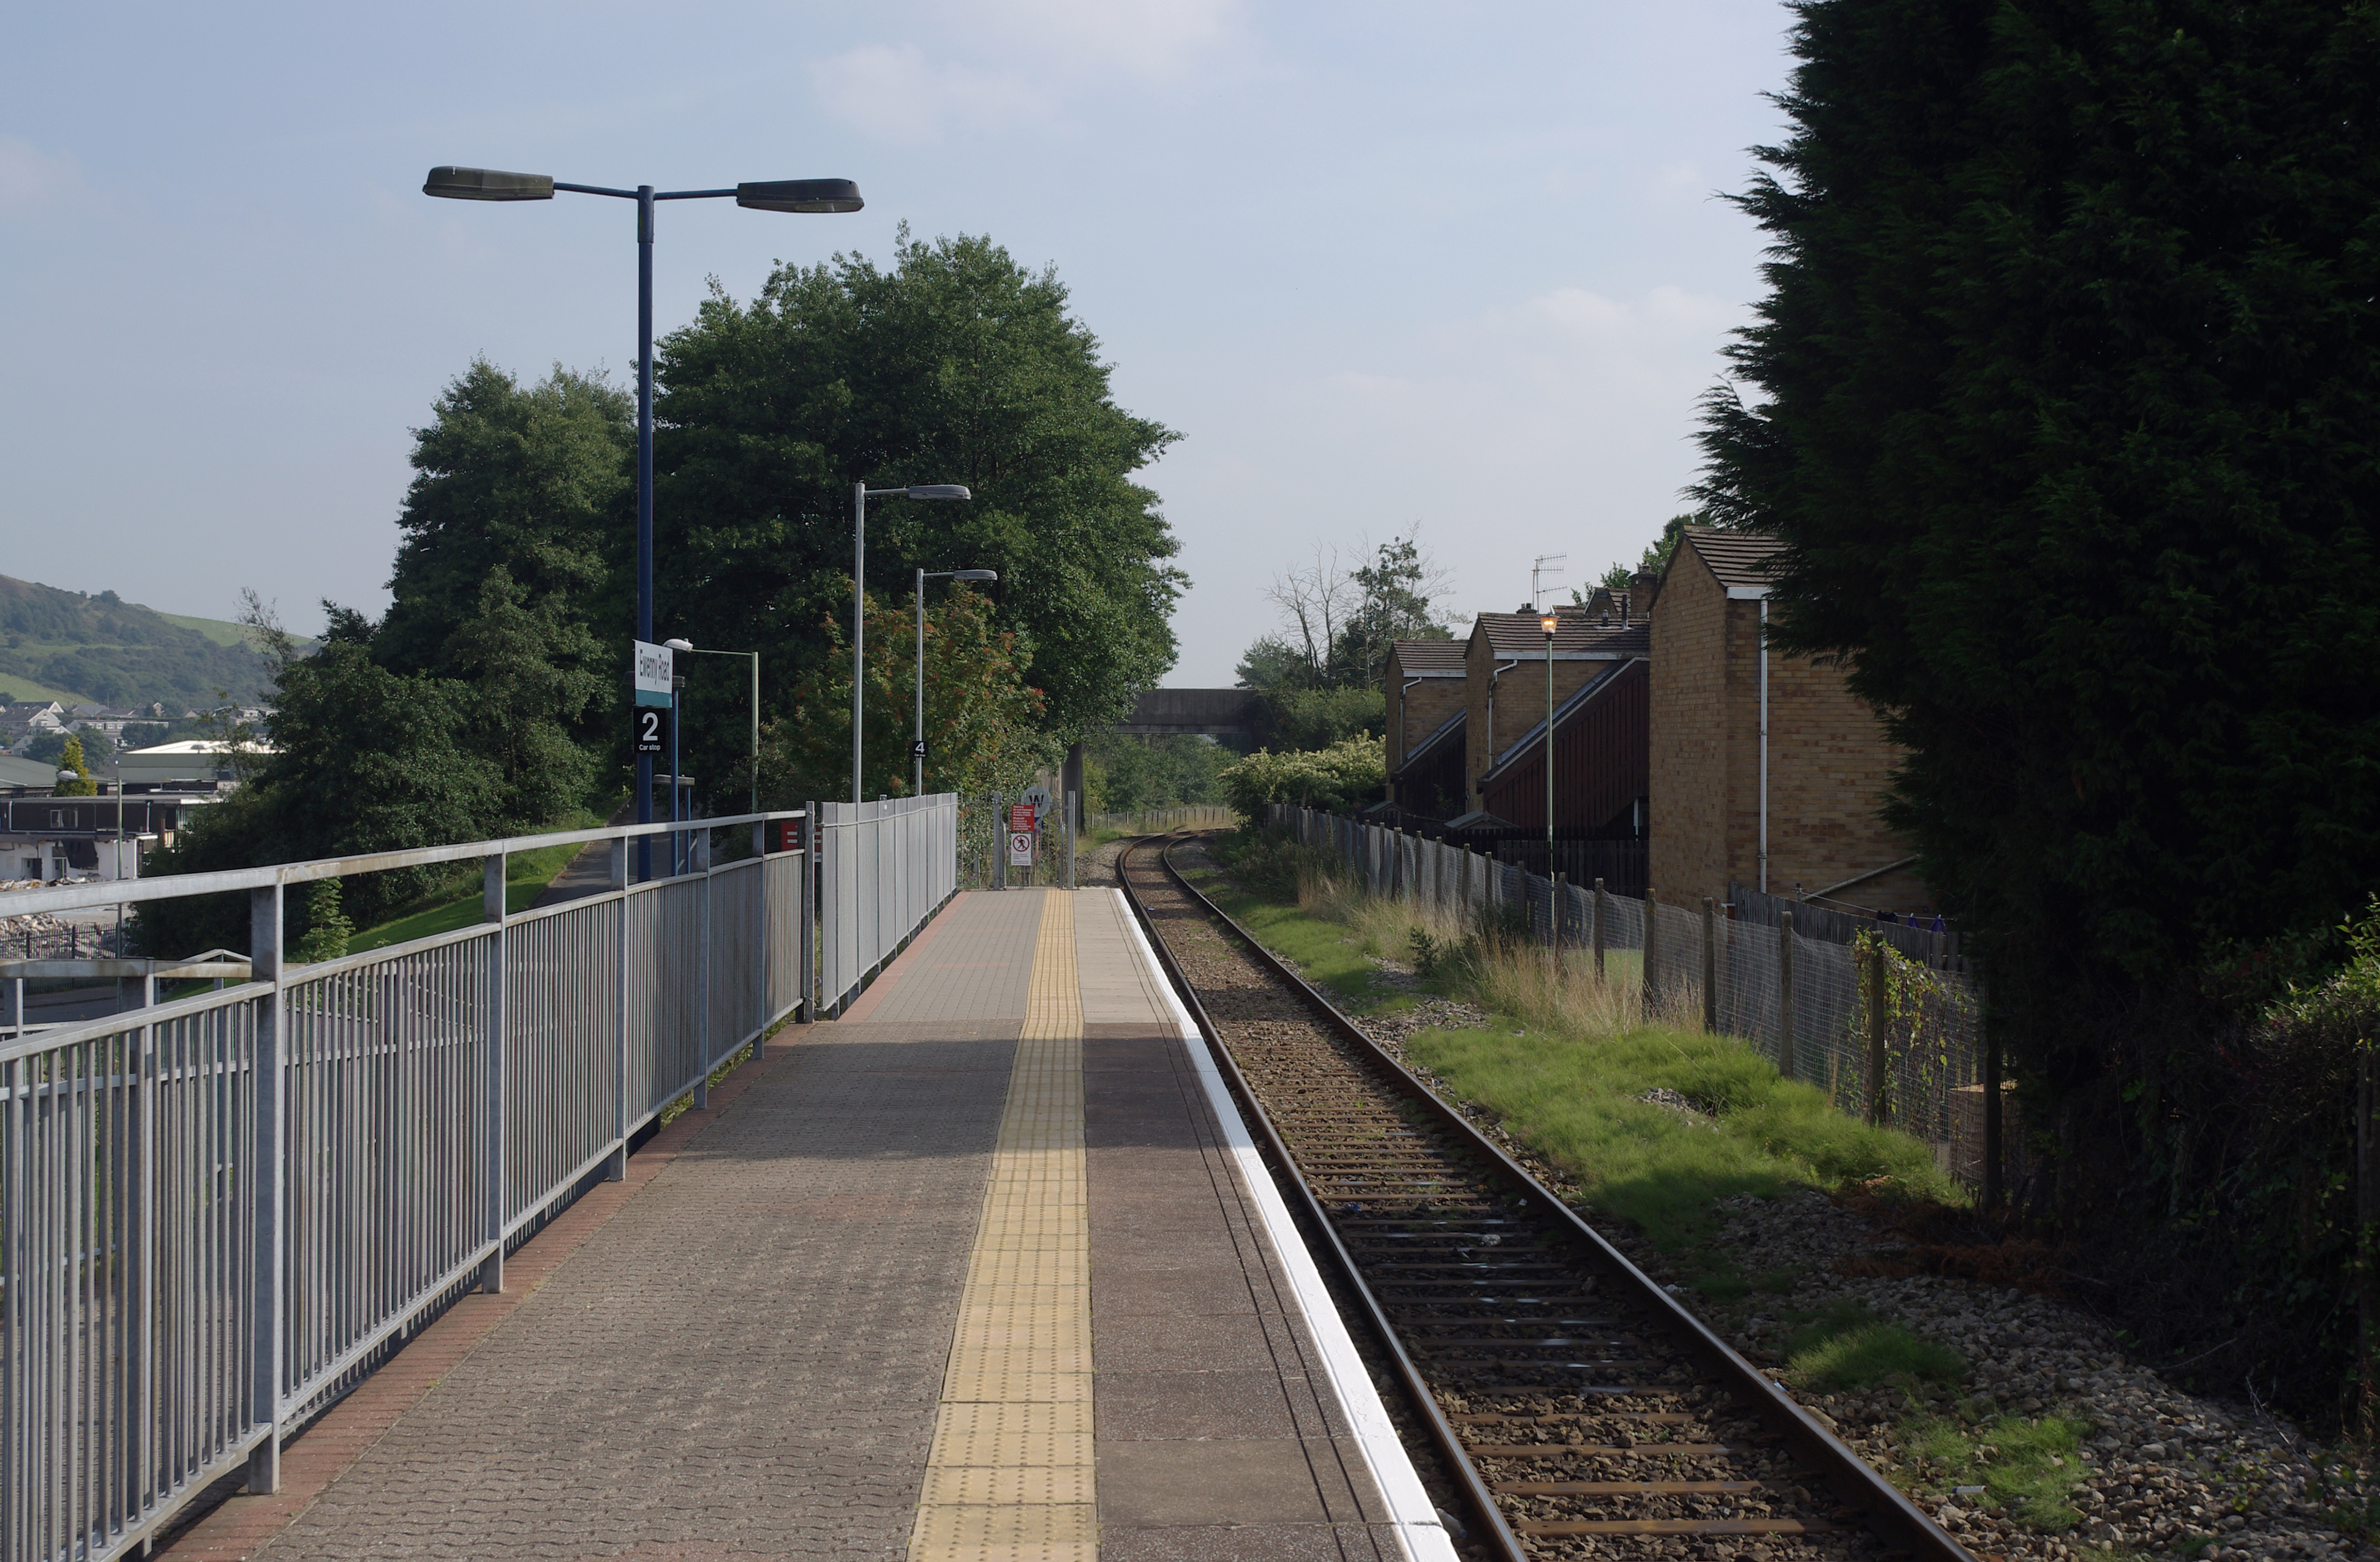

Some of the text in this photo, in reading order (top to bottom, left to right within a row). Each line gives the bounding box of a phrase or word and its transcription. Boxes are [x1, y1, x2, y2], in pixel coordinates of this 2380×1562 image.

[640, 649, 669, 685] Ewenny Road
[642, 712, 658, 741] 2
[915, 742, 925, 753] 4
[1029, 794, 1044, 808] W
